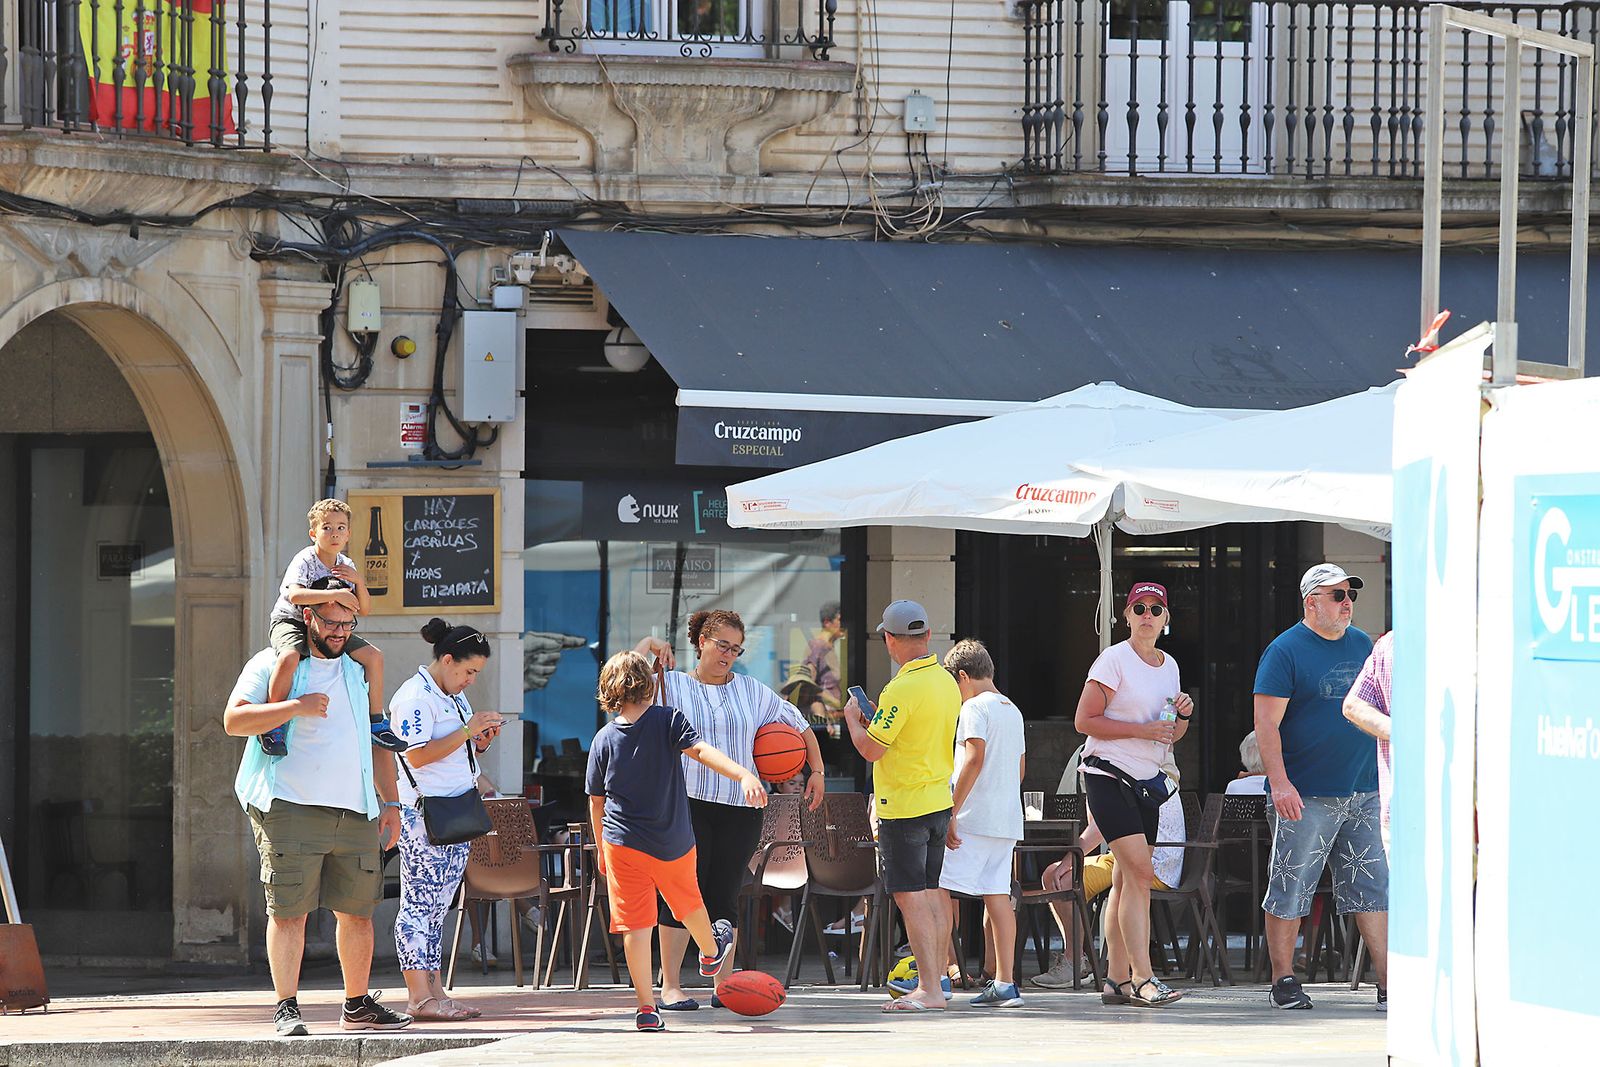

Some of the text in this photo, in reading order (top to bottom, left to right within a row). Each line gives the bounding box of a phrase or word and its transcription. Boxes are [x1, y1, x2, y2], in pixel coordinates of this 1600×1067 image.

[714, 421, 802, 444] Cruzcampo
[732, 444, 784, 456] ESPECIAL
[1015, 483, 1096, 507] Cruzcampo
[424, 497, 456, 518] HAY
[404, 518, 480, 531] CARACOLES
[366, 560, 388, 570] 1906
[656, 559, 712, 571] PAAISO
[406, 567, 442, 580] HABAS
[1135, 586, 1163, 597] adidas
[412, 709, 422, 735] vivo
[883, 706, 898, 729] vivo
